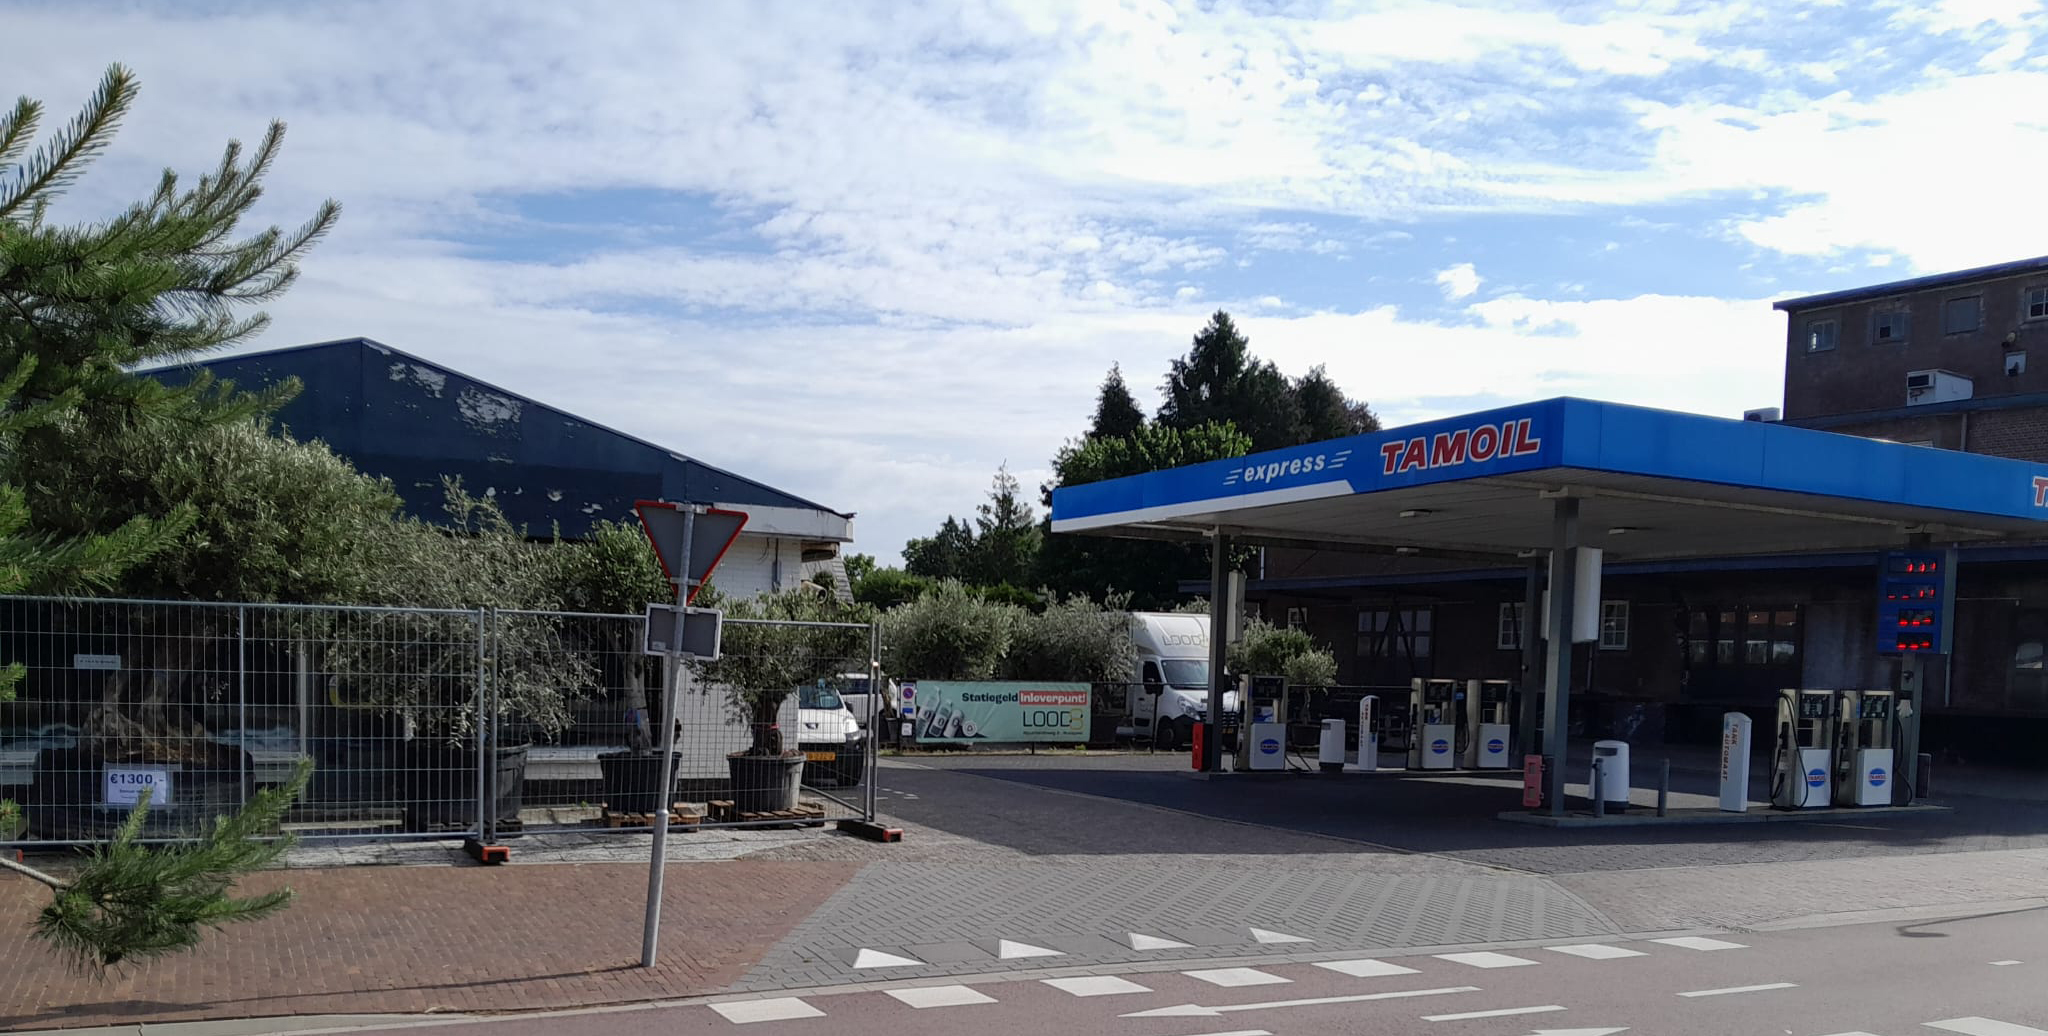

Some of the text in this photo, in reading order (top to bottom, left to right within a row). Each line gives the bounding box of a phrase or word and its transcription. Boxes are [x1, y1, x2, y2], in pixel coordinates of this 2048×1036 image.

[1380, 418, 1541, 474] TAMOIL
[1243, 453, 1325, 484] express
[2032, 476, 2048, 508] T
[1161, 634, 1208, 648] LOOD
[961, 691, 1086, 705] Statiegeld Inleverpunt!
[1730, 724, 1739, 745] TANK
[1722, 733, 1730, 781] AUTOMAAT
[110, 773, 165, 786] €1300,-
